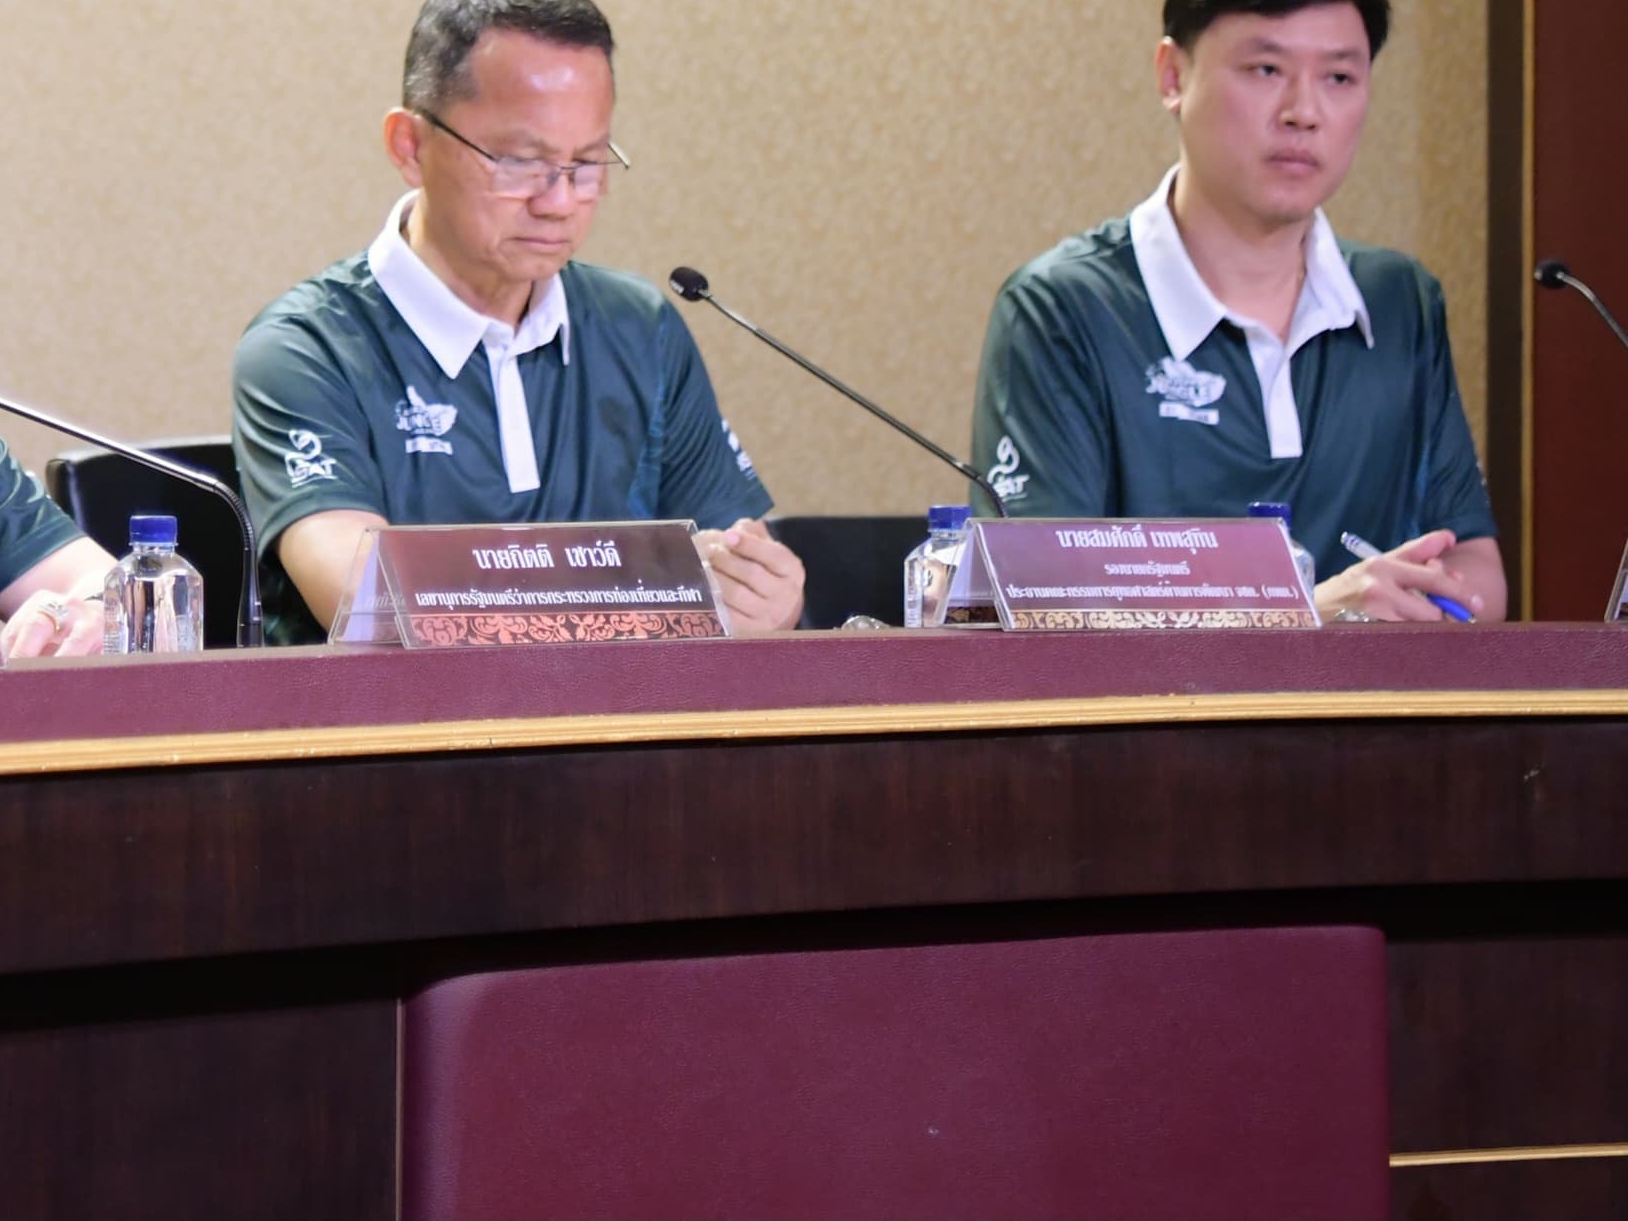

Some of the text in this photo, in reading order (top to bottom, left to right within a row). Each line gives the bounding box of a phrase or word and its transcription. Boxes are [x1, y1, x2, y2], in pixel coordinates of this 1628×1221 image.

[472, 540, 622, 569] นายกิตติ เชาว์ดี
[1149, 527, 1219, 554] เทพสุทิน
